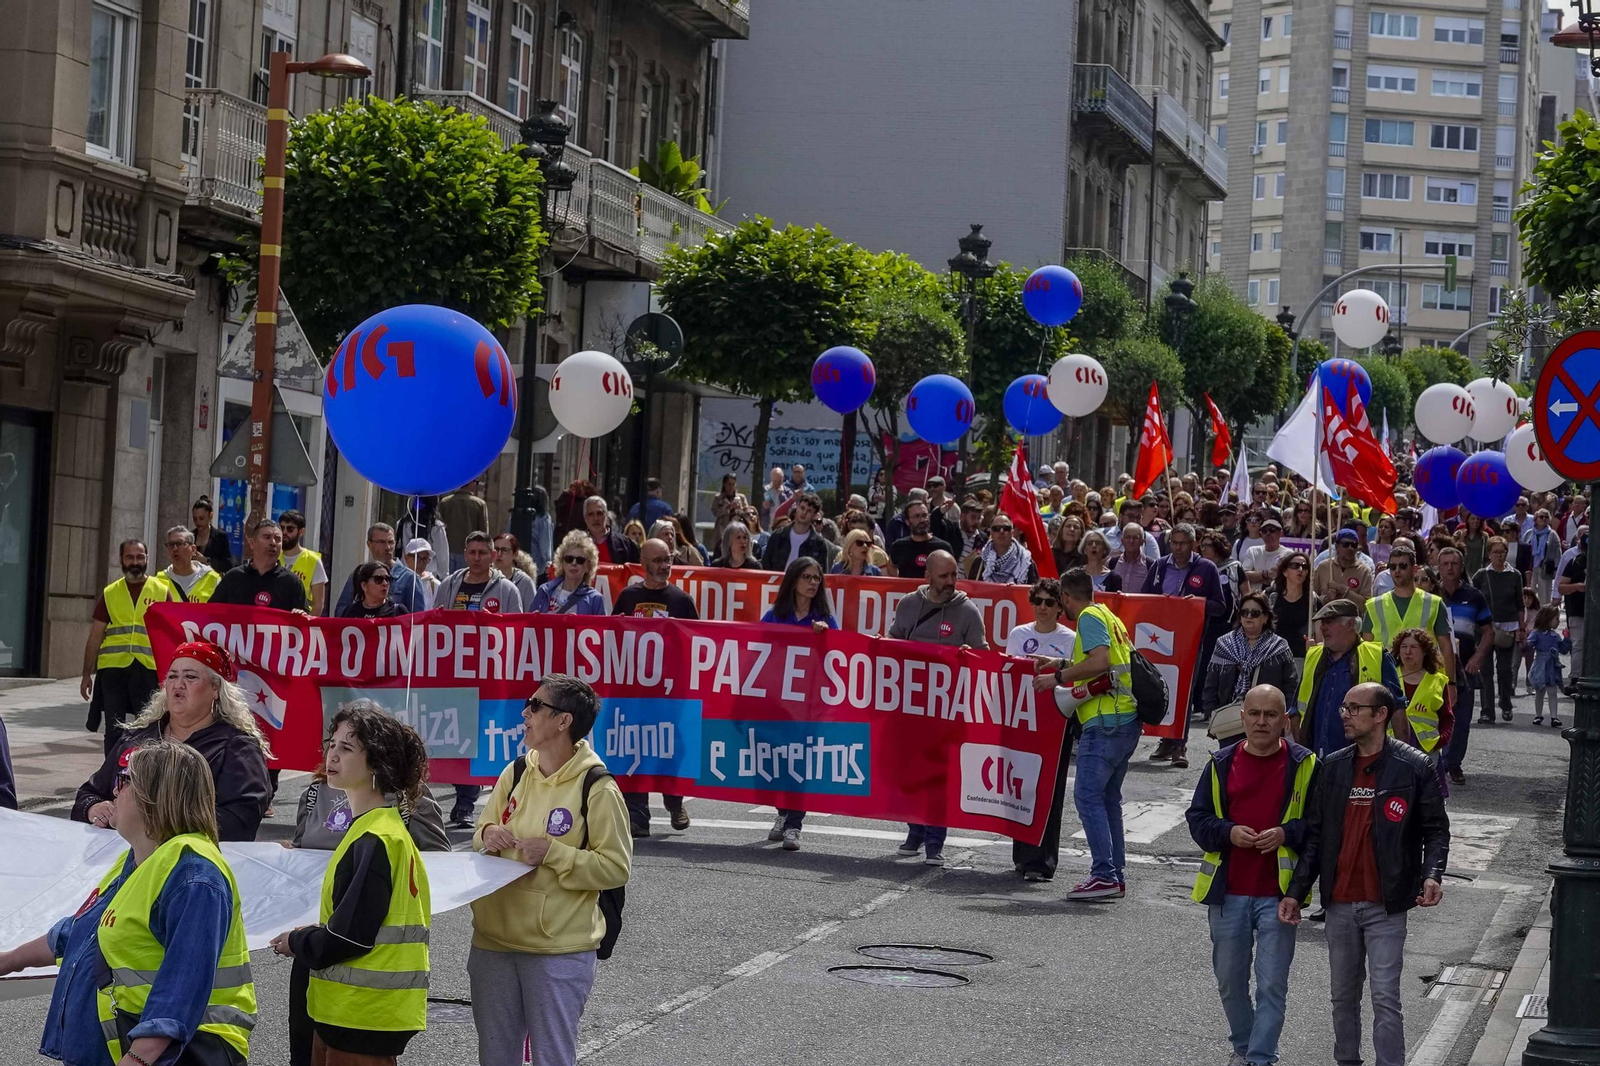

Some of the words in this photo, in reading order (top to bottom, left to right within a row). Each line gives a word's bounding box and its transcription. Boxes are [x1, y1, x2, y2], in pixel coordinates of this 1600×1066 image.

[602, 371, 632, 399] CIG
[1076, 367, 1103, 386] CIG
[1453, 396, 1475, 421] CIG
[340, 626, 366, 678] O
[375, 624, 674, 695] IMPERIALISMO,
[690, 635, 772, 698] PAZ
[781, 645, 811, 702] E
[820, 650, 1038, 732] SOBERANÍA
[606, 707, 675, 777] digno
[710, 740, 727, 781] e
[738, 727, 865, 785] dereitos
[981, 756, 1024, 800] CIG
[1388, 800, 1404, 815] CIG
